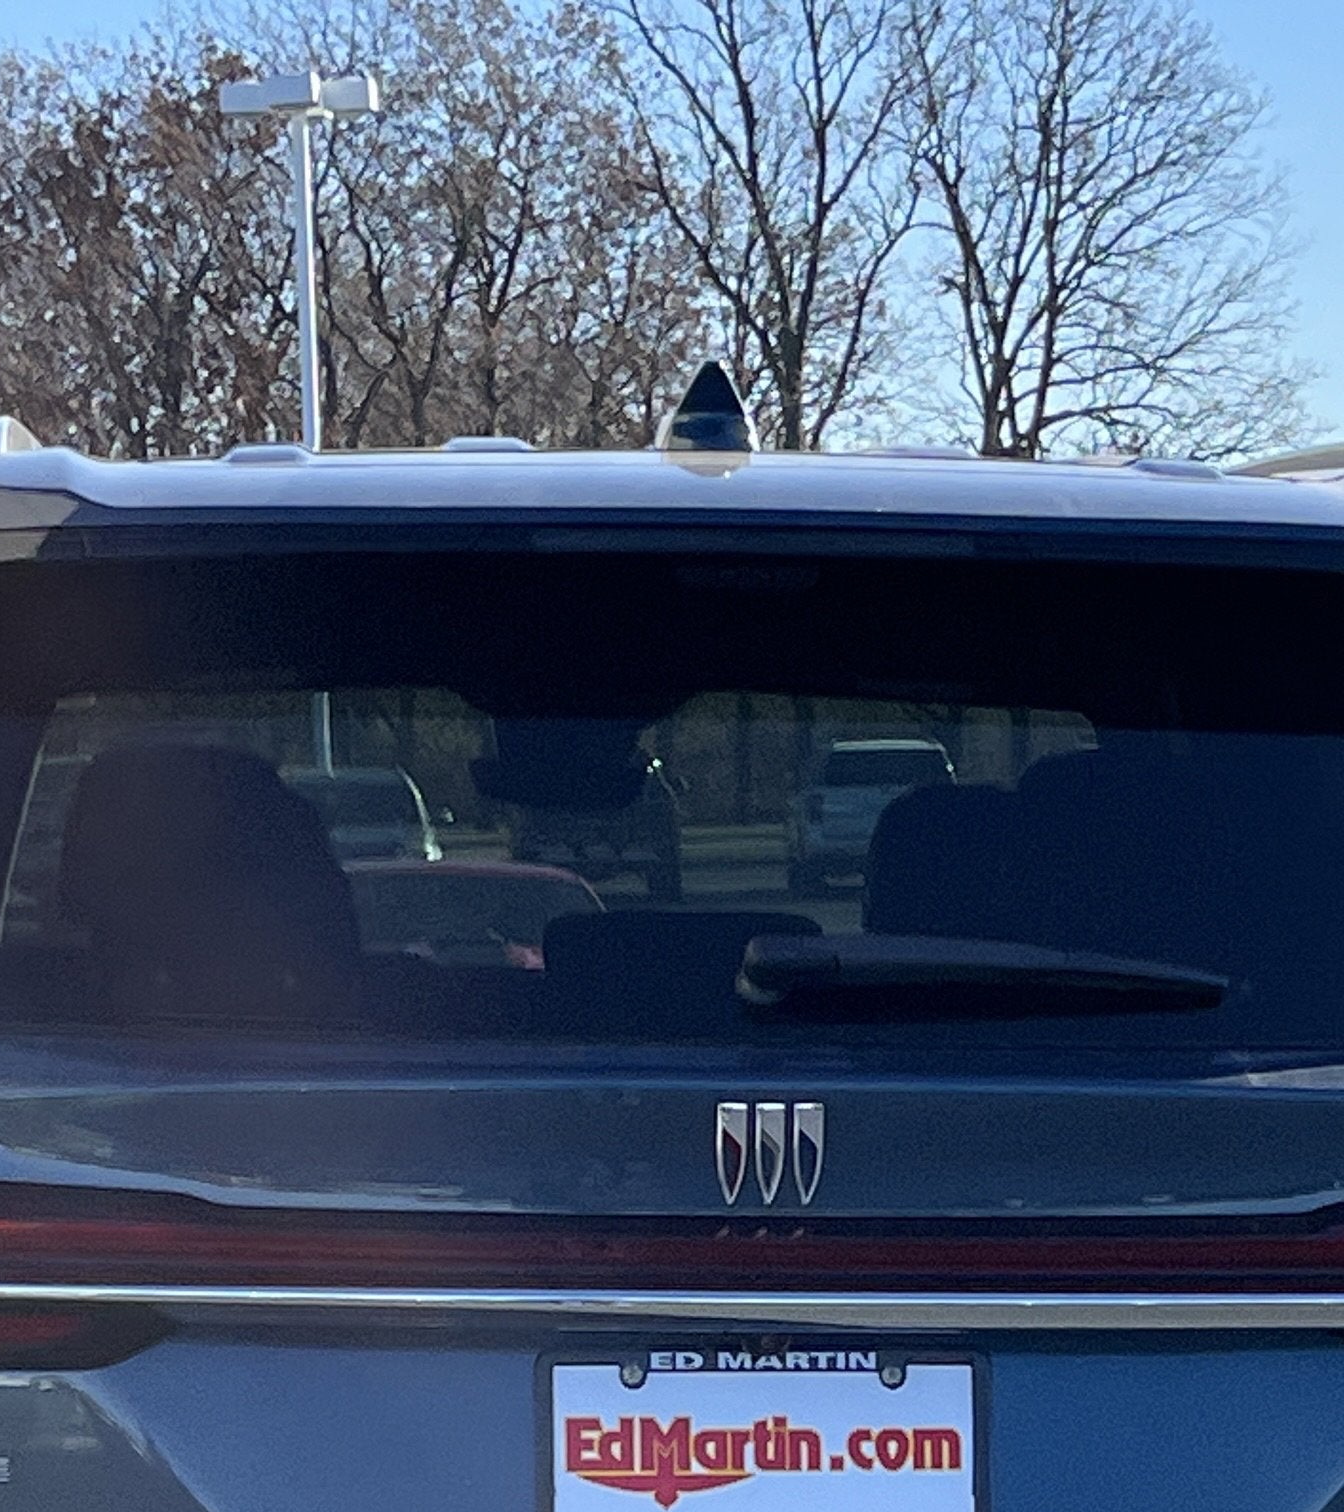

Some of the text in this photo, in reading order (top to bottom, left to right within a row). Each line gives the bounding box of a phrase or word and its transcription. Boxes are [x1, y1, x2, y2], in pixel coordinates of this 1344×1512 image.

[649, 1351, 877, 1370] ED MARTIN
[564, 1416, 962, 1472] EdMartin.com
